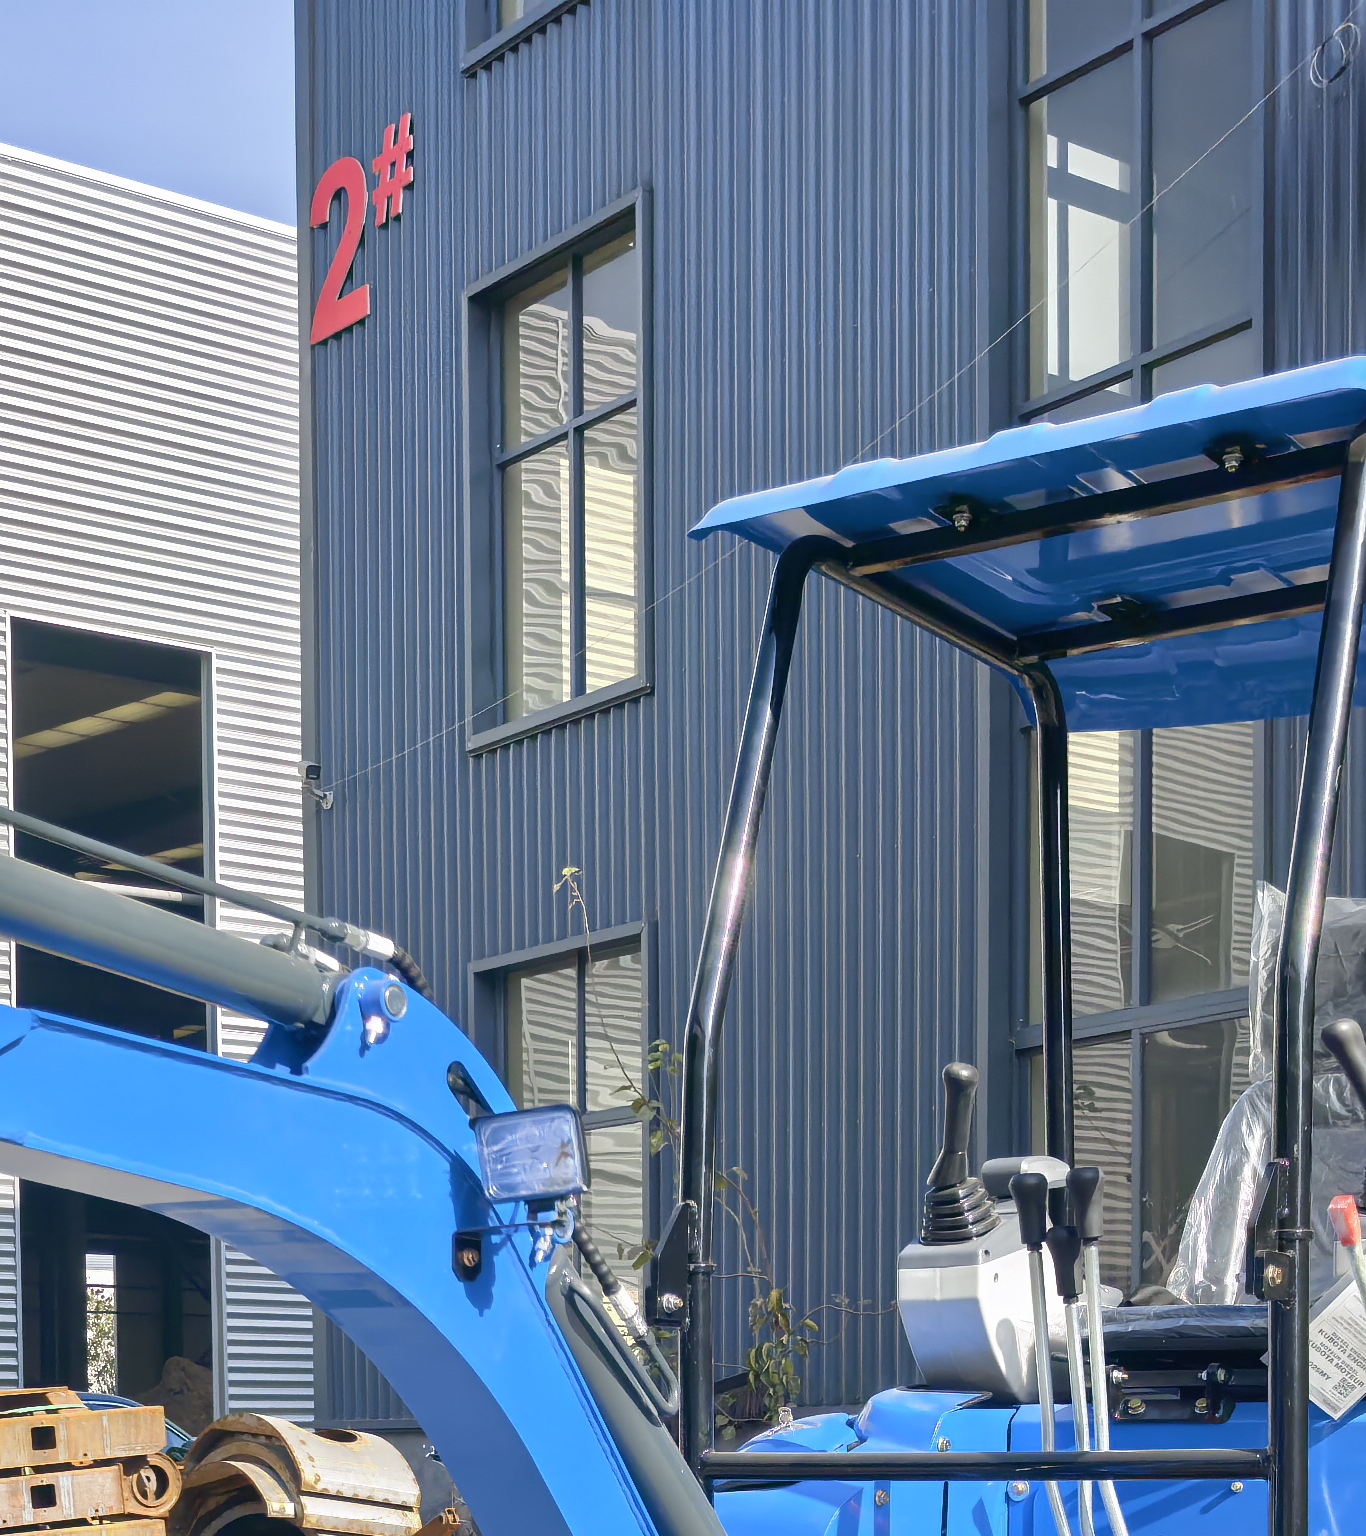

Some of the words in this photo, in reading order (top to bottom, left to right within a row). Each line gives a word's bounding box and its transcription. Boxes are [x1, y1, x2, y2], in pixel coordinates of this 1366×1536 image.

[309, 112, 413, 345] 2#
[1318, 1328, 1347, 1355] KUBOTA
[1334, 1362, 1365, 1388] MOTEUR
